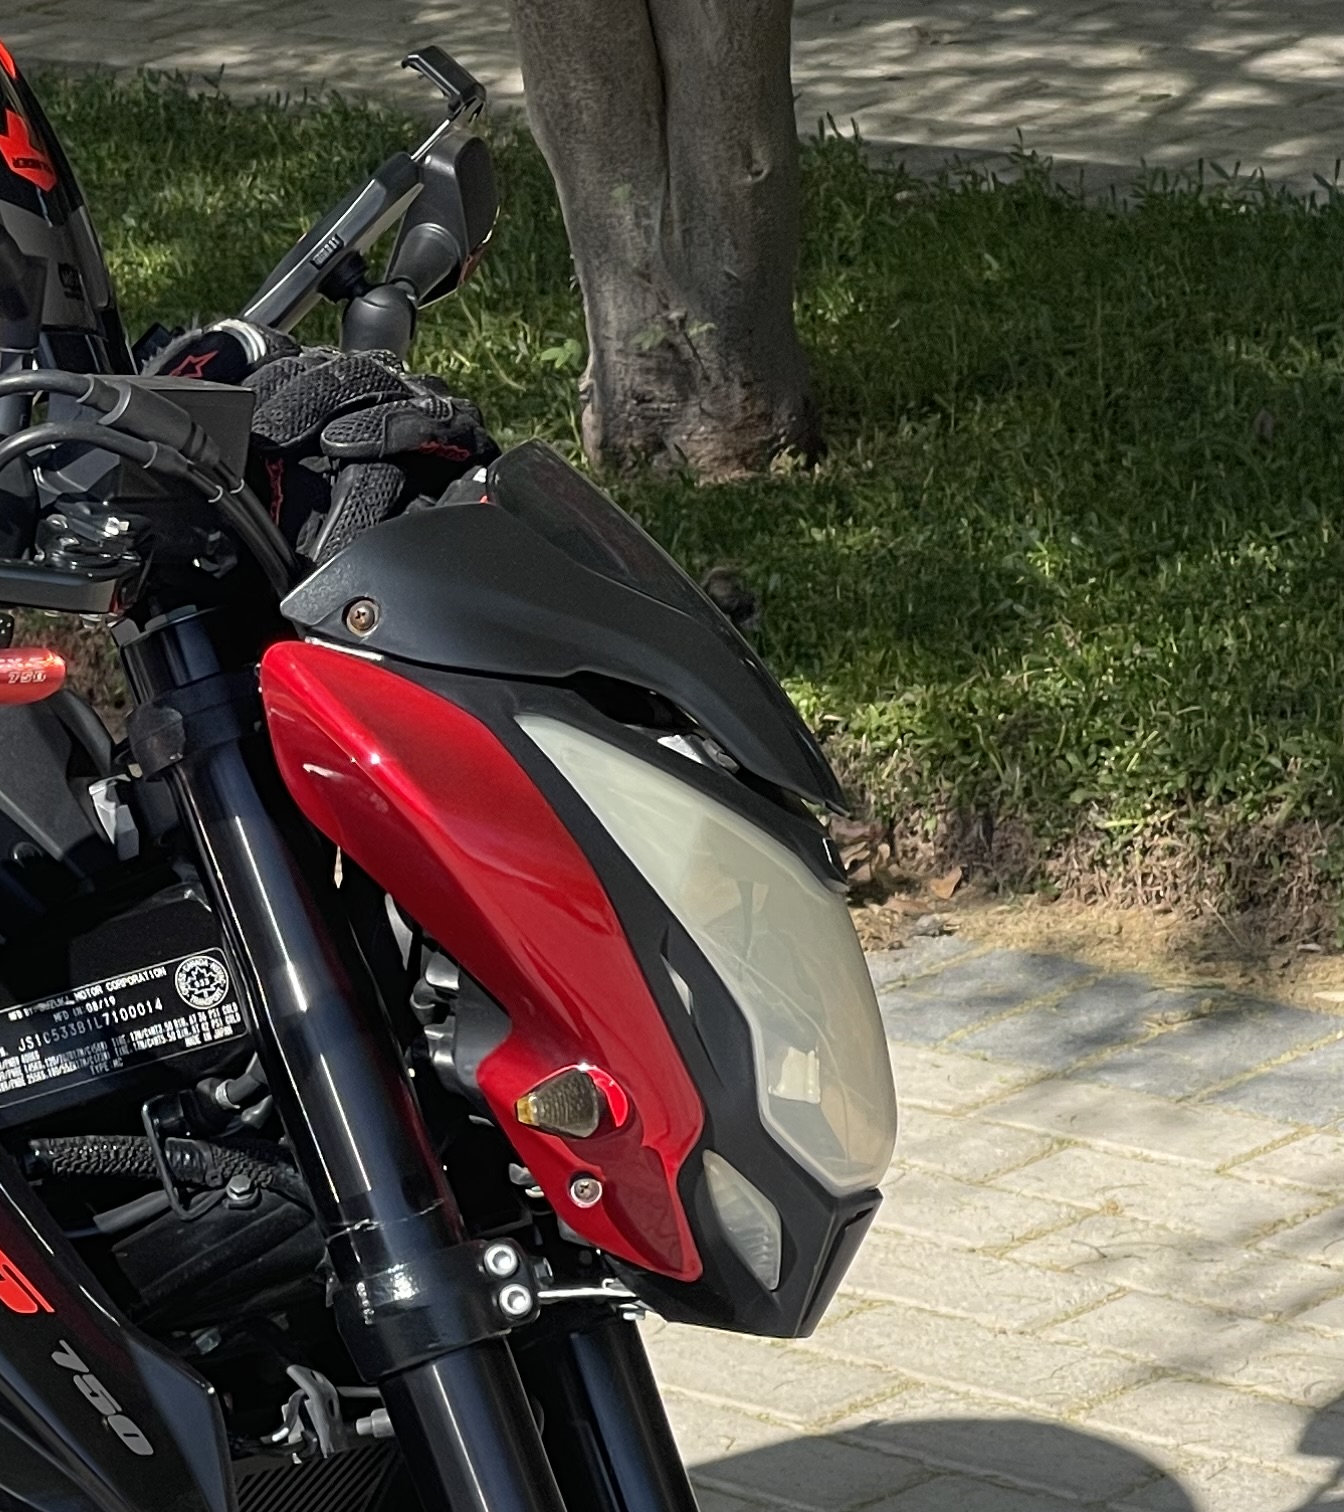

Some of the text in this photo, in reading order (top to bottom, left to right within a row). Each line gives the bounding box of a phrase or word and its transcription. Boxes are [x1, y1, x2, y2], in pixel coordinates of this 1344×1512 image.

[73, 984, 104, 1002] MOTOR
[104, 966, 167, 992] CORPORATION
[50, 1339, 154, 1456] 750
